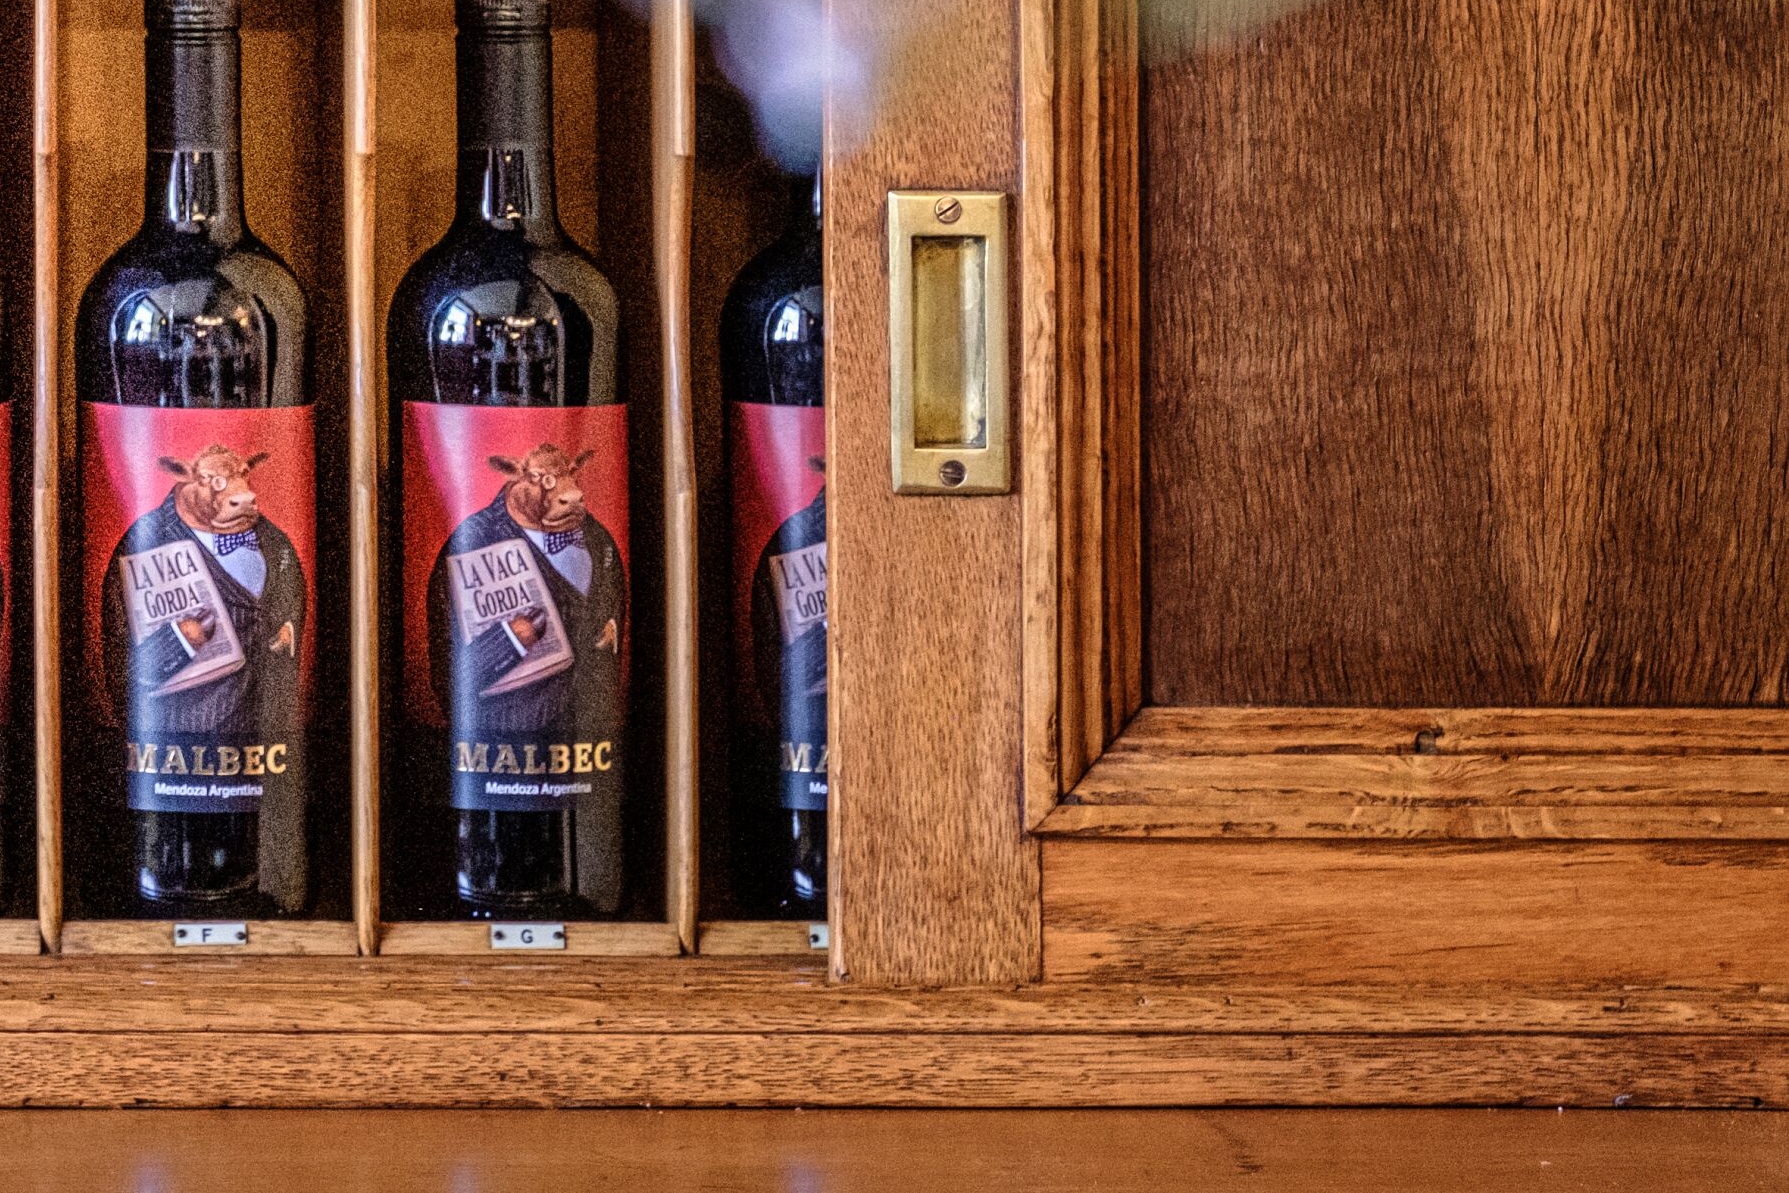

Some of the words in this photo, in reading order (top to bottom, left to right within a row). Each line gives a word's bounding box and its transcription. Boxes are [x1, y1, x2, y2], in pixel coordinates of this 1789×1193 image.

[129, 558, 152, 590] LA
[151, 550, 199, 580] VACA
[457, 557, 482, 590] LA
[481, 548, 529, 580] VACA
[778, 558, 805, 589] LA
[802, 552, 827, 582] VA
[144, 590, 200, 620] GORDA
[474, 588, 531, 618] GORDA
[795, 590, 828, 617] GOR
[127, 743, 287, 776] MALBEC
[457, 740, 611, 774] MALBEC
[155, 783, 208, 796] Mendoza
[209, 782, 263, 797] Argentina
[486, 781, 539, 795] Mendoza
[541, 781, 591, 796] Argentina
[202, 928, 212, 942] F
[520, 929, 534, 944] G
